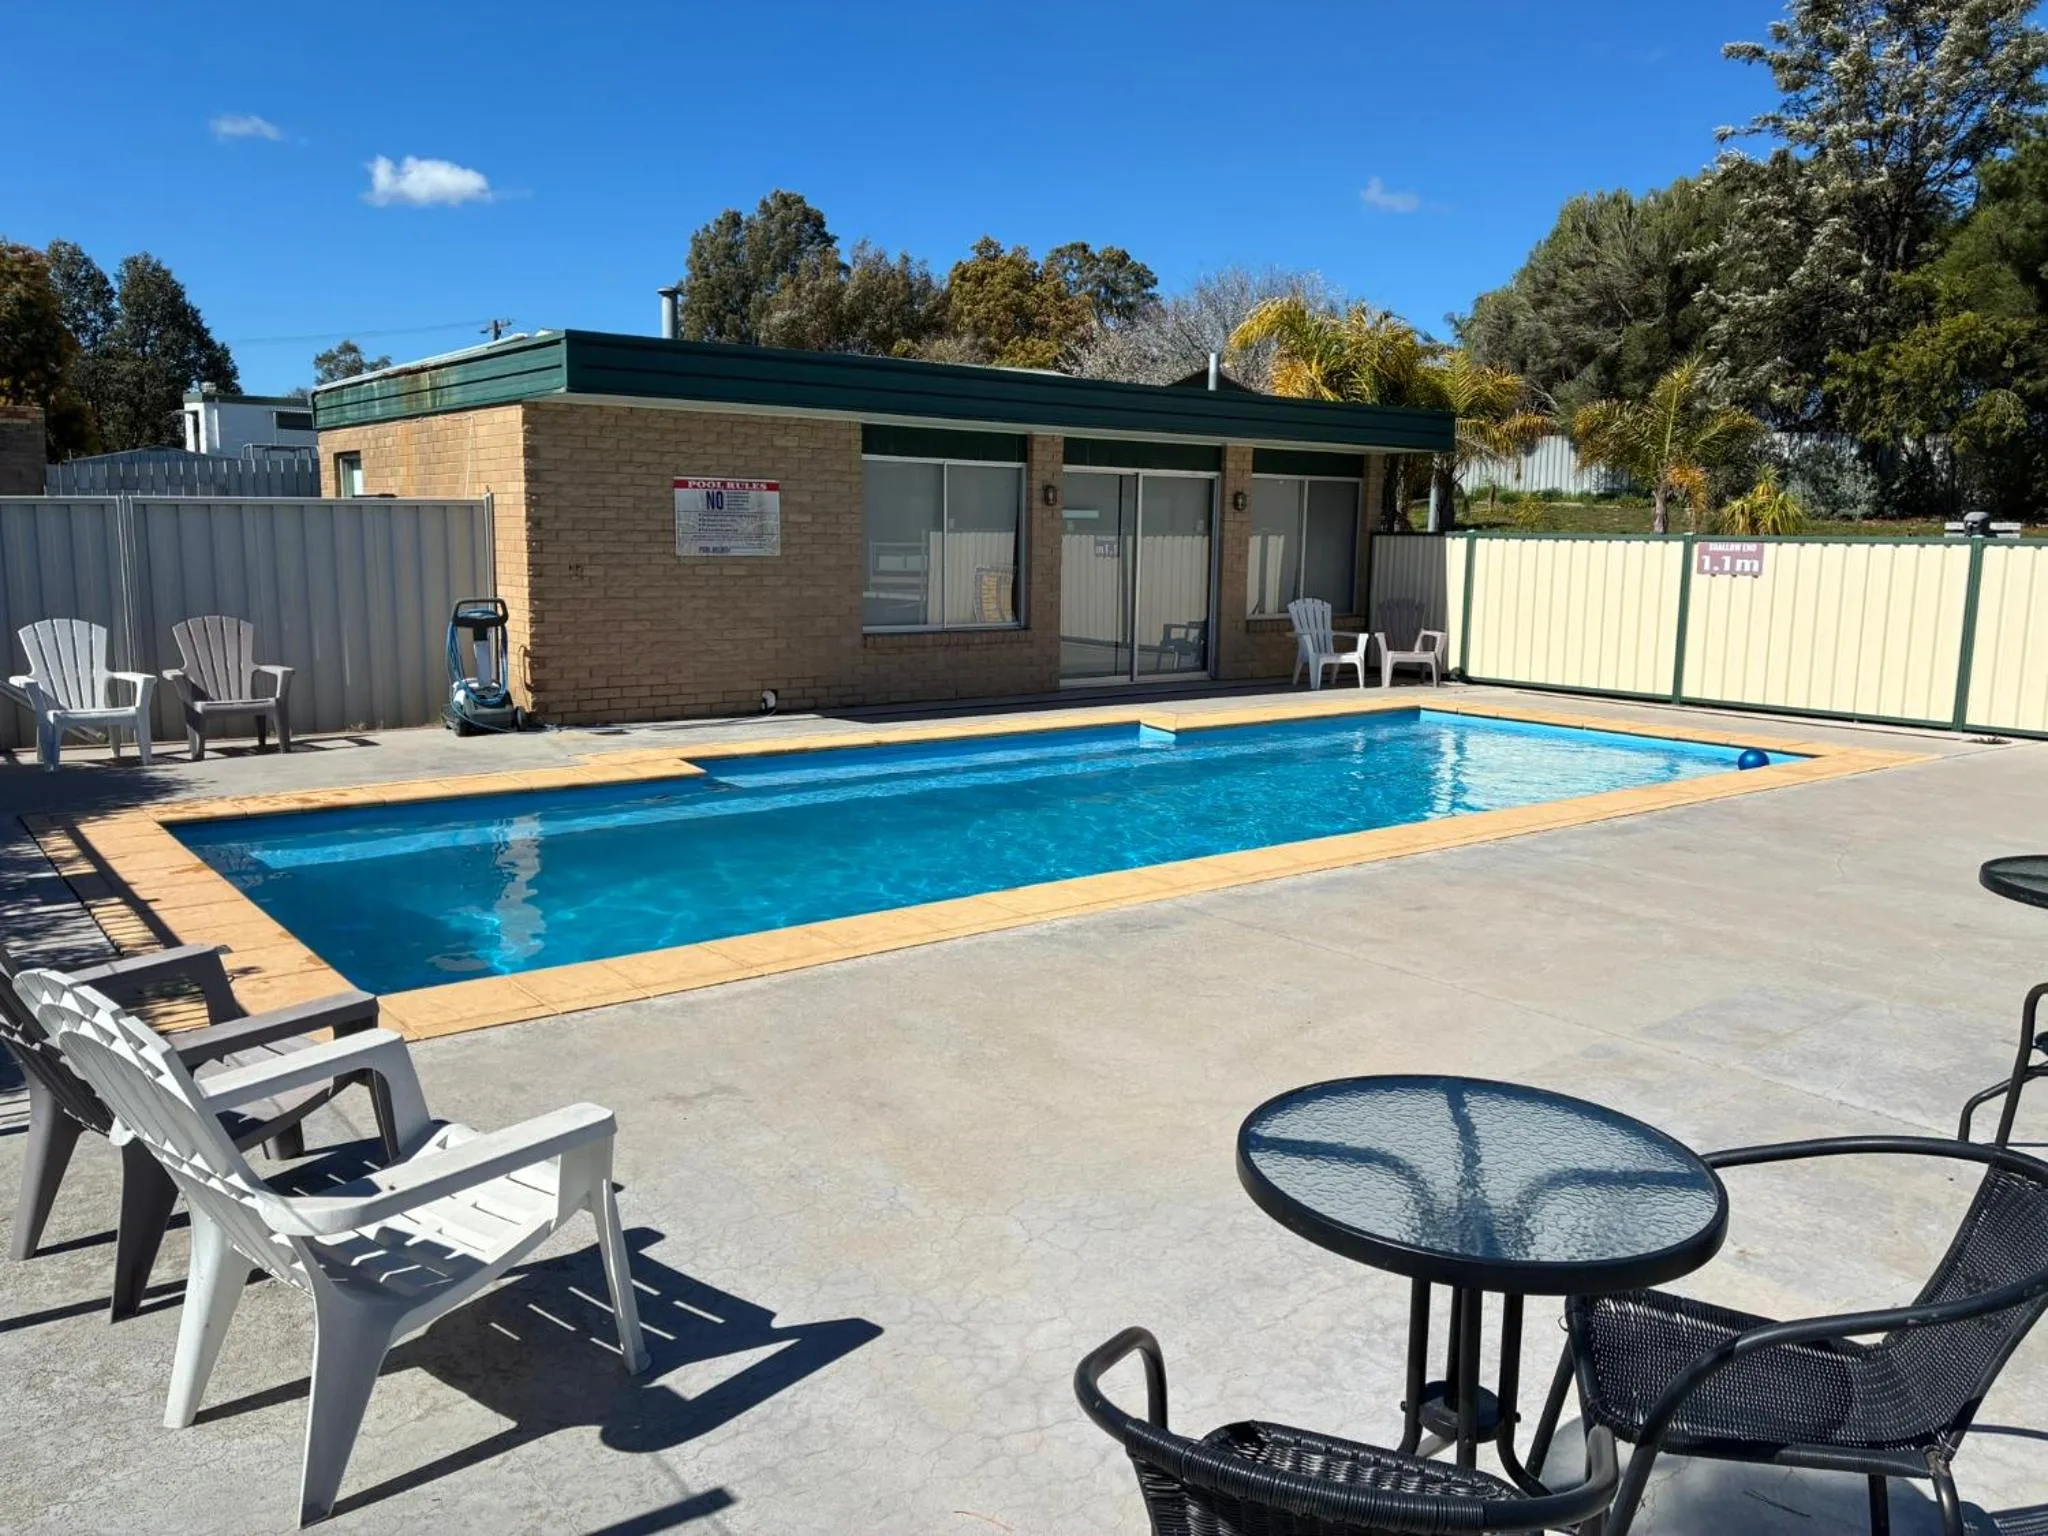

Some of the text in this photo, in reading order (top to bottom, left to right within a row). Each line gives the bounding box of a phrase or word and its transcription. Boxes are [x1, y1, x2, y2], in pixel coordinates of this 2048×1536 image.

[688, 481, 767, 491] POOL RULES
[706, 491, 724, 510] NO
[1702, 555, 1759, 572] 1.1m
